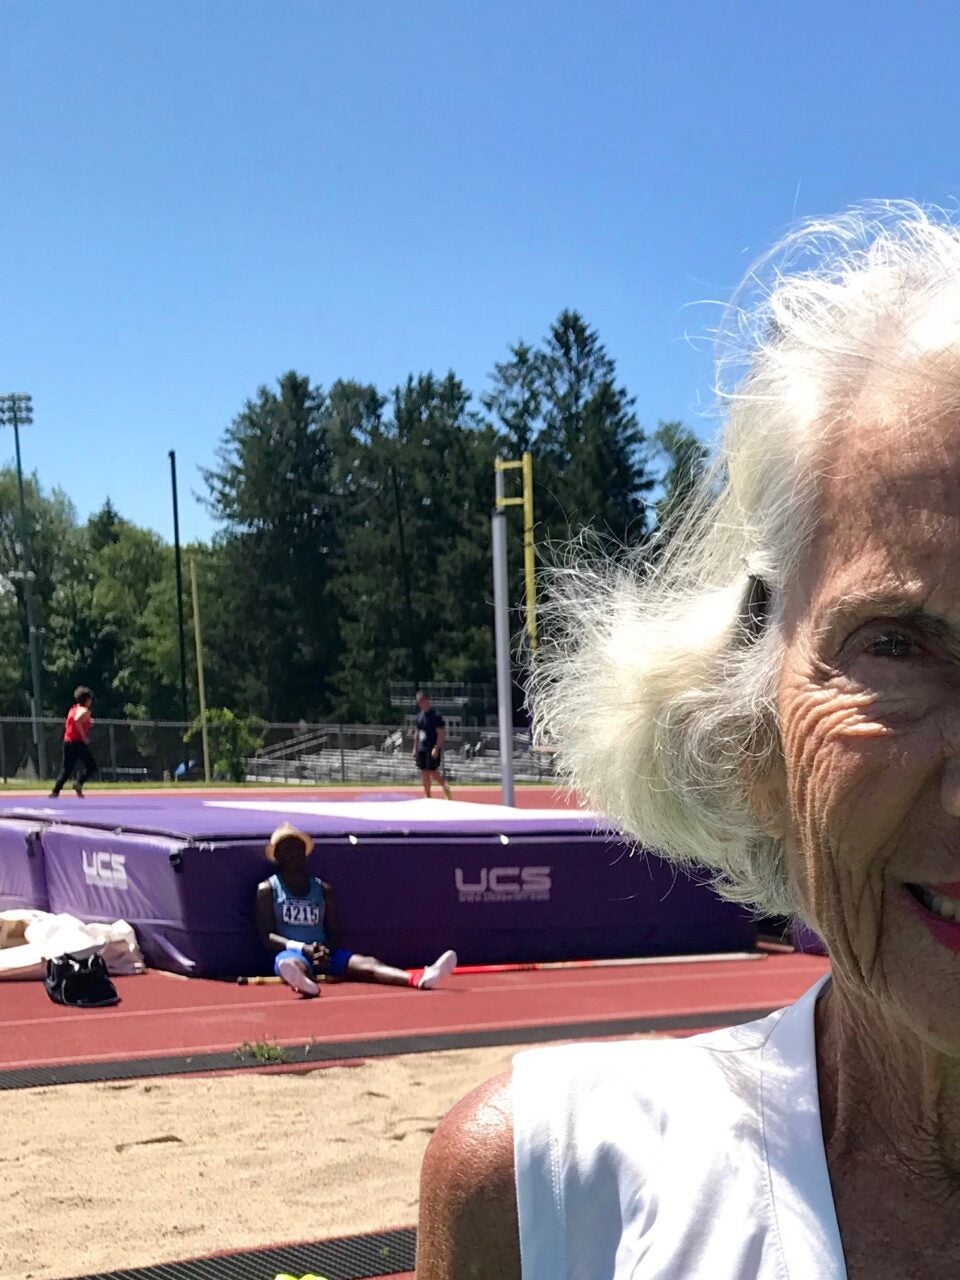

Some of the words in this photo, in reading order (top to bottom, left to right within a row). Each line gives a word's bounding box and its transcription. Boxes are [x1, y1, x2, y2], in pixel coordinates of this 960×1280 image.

[82, 849, 128, 879] UCS
[454, 866, 552, 891] UCS
[284, 905, 319, 924] 4215
